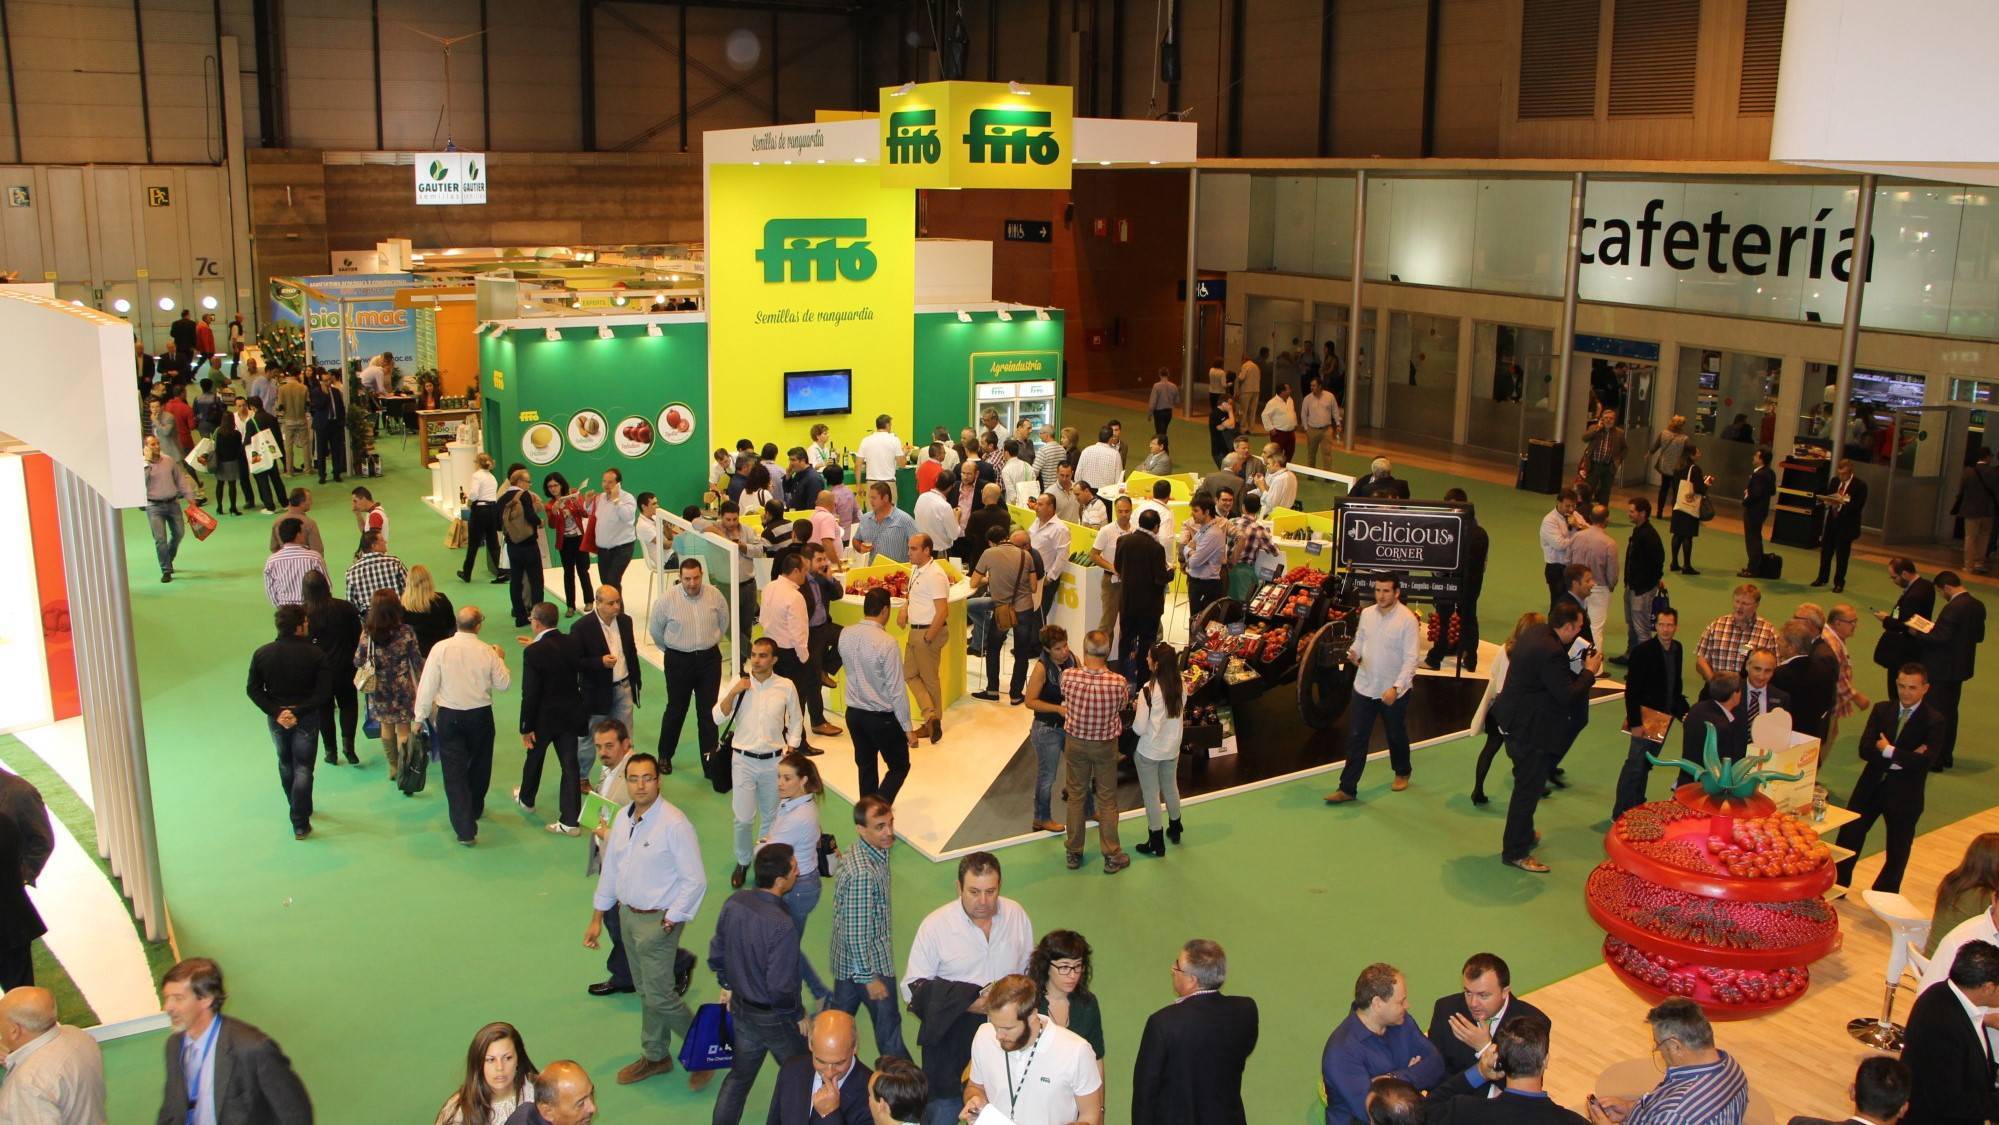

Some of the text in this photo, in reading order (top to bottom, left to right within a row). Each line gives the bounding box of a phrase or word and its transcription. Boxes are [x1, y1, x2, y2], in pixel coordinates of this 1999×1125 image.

[751, 129, 824, 157] Semillas de vanguardia
[886, 109, 941, 165] fitó
[962, 108, 1060, 166] fitó
[418, 183, 459, 192] GAUTIER
[463, 182, 485, 192] GAUTIER
[755, 217, 878, 284] fitó
[754, 306, 874, 328] Semillas de vanguardia
[990, 360, 1042, 377] Agroindustria
[1354, 519, 1449, 545] Delicious
[1375, 545, 1424, 560] CORNER
